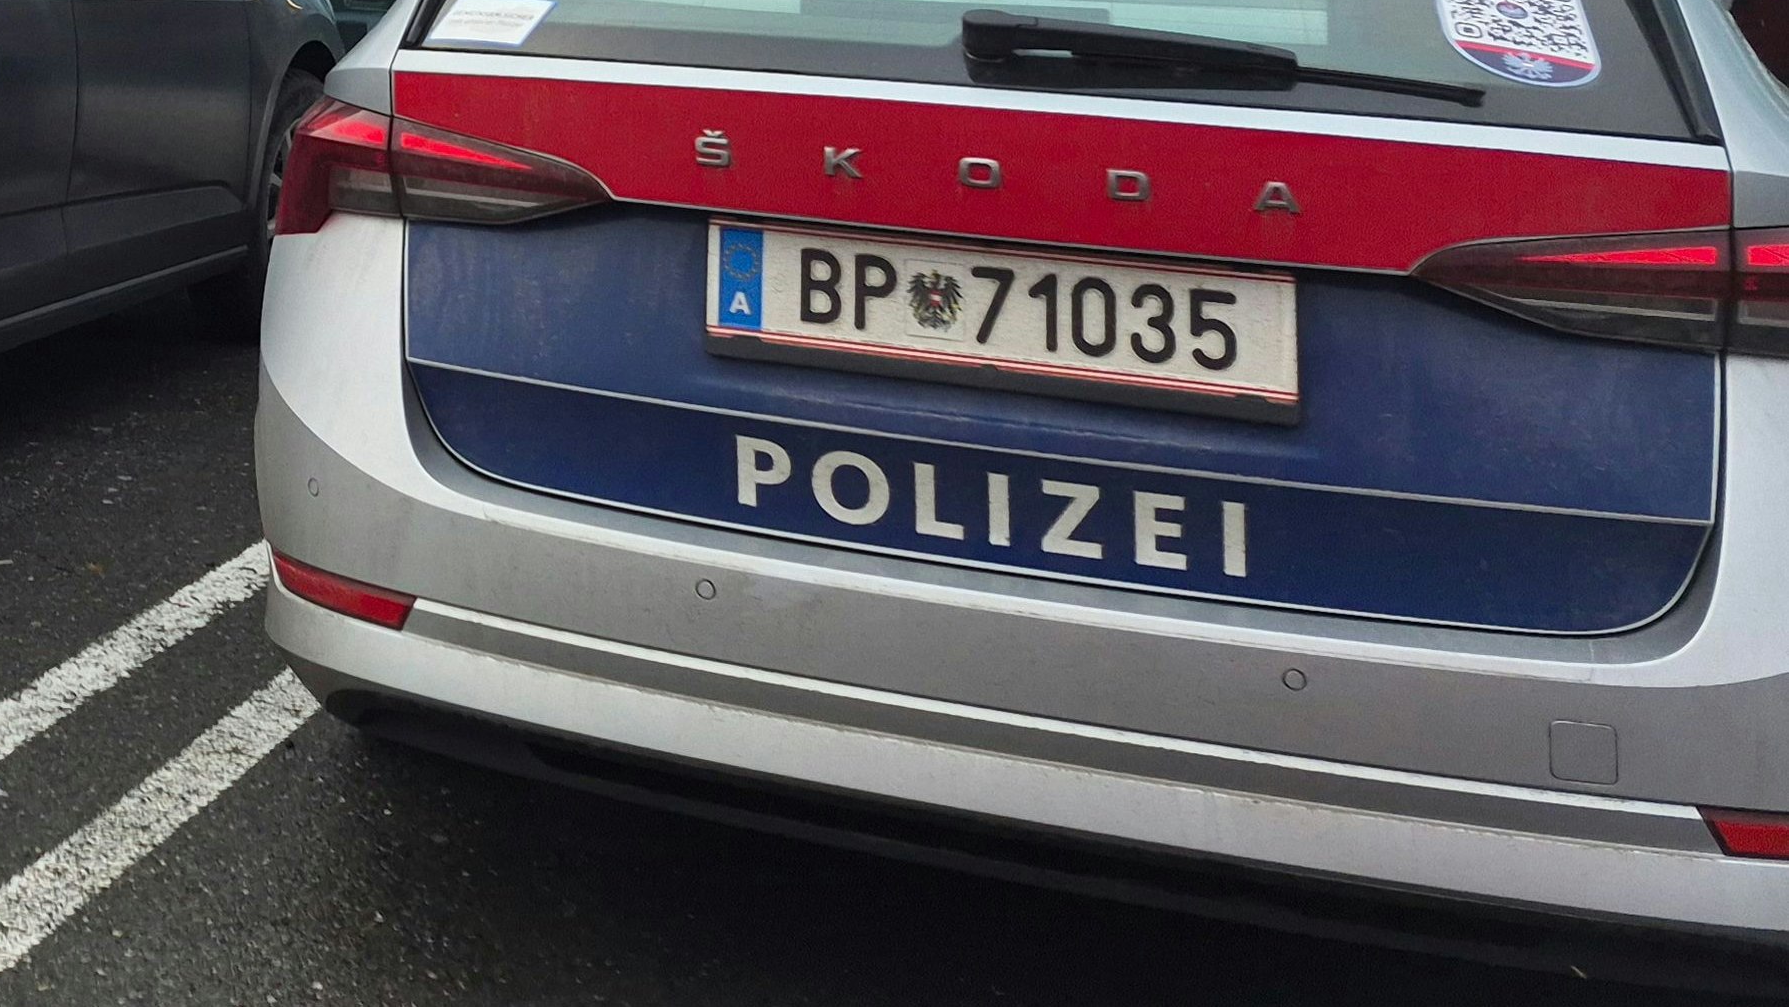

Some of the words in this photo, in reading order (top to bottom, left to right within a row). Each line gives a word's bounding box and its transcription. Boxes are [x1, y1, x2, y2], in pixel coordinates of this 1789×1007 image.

[694, 128, 1301, 215] ŠKODA
[728, 290, 752, 315] A
[799, 248, 897, 330] BP
[971, 266, 1237, 371] 71035
[735, 435, 1246, 577] POLIZEI
